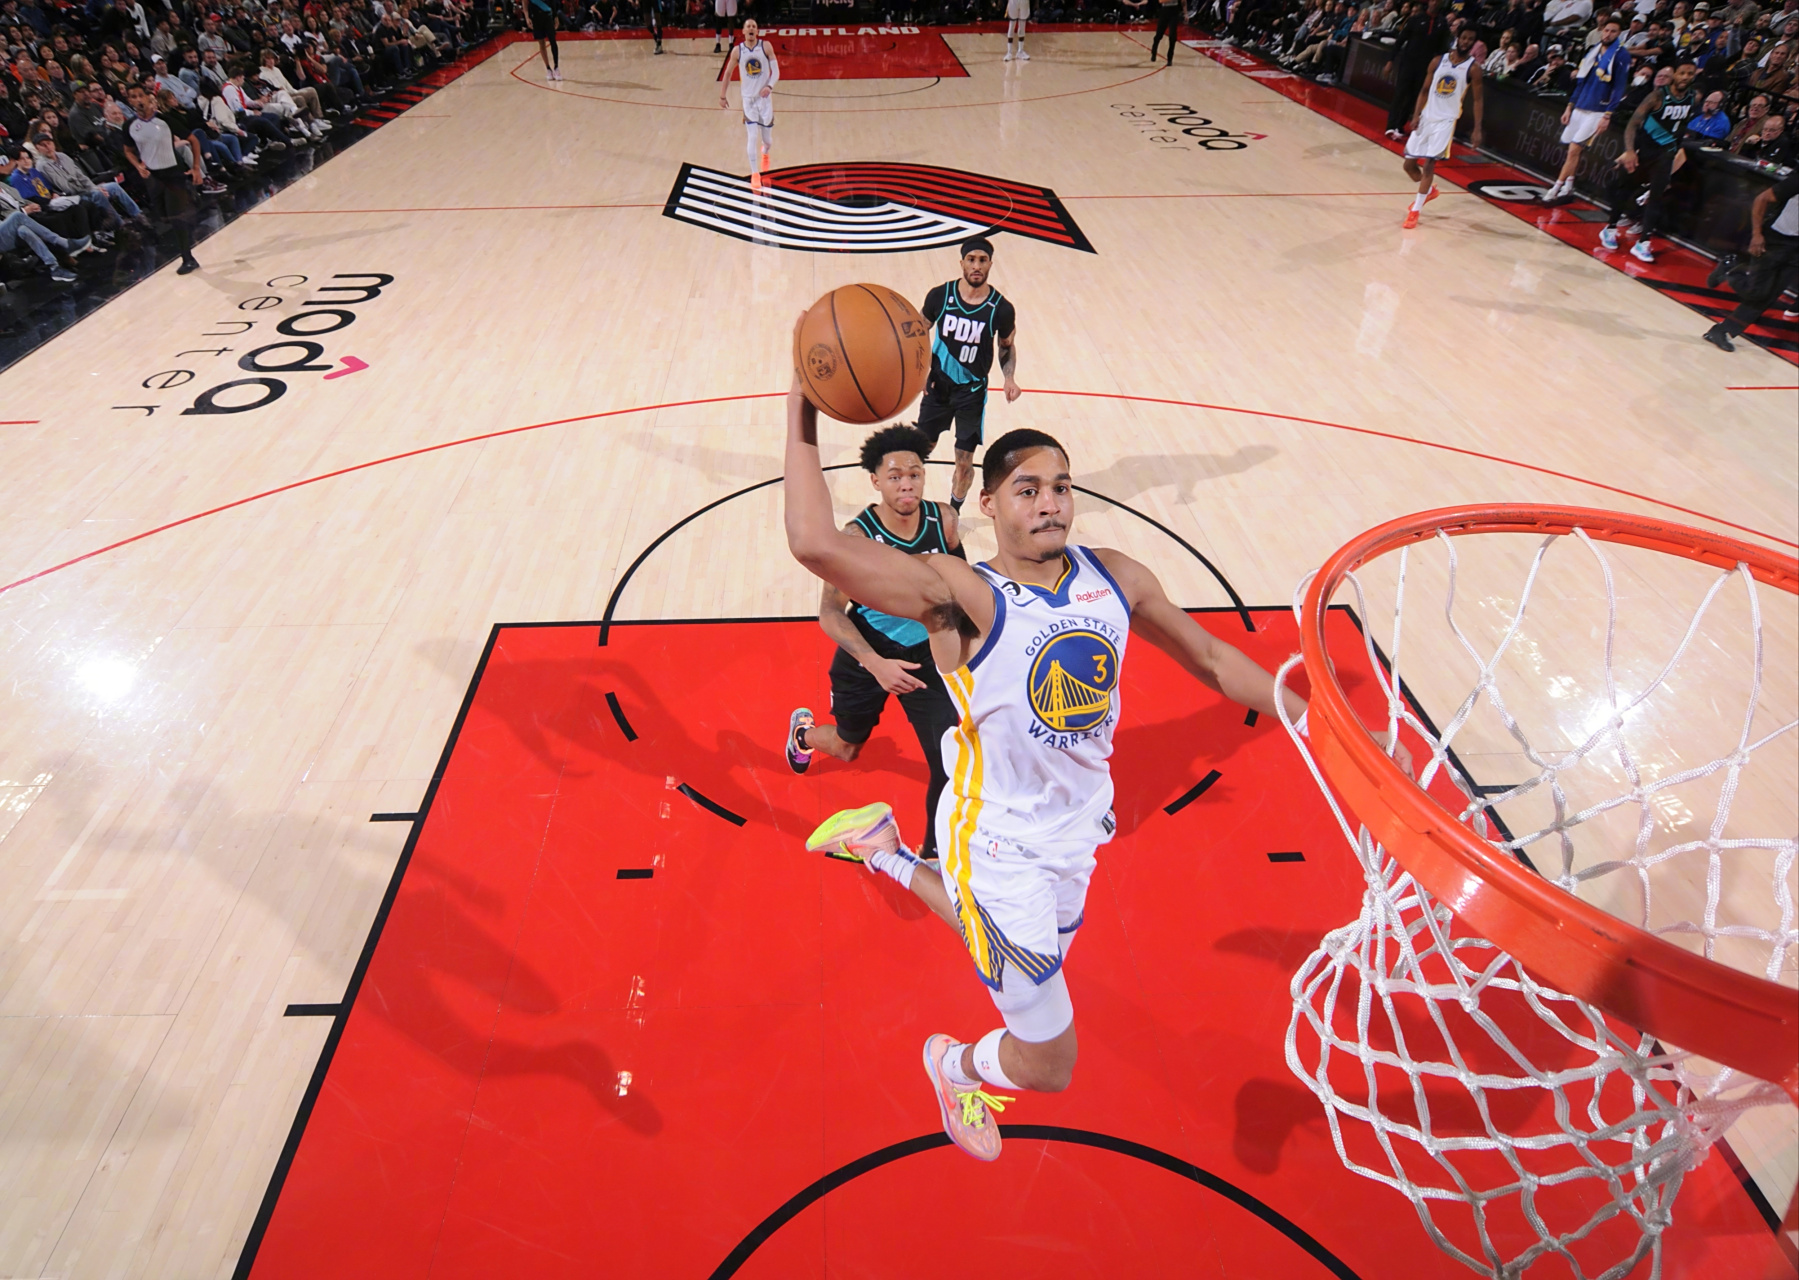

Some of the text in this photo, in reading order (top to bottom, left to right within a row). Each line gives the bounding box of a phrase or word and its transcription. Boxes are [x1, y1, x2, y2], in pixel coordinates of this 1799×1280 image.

[758, 27, 920, 36] PORTLAND
[1110, 103, 1191, 151] center
[1146, 103, 1248, 150] moda
[1527, 109, 1555, 137] FOR
[1661, 105, 1692, 120] PDX
[1515, 130, 1540, 157] THE
[942, 313, 986, 344] PDX
[111, 274, 309, 417] center
[179, 273, 395, 416] moda
[959, 344, 978, 364] 00
[1075, 588, 1112, 602] Rakuten
[1025, 618, 1120, 657] GOLDEN STATE
[1092, 654, 1108, 684] 3
[1027, 703, 1114, 749] WARRIOR
